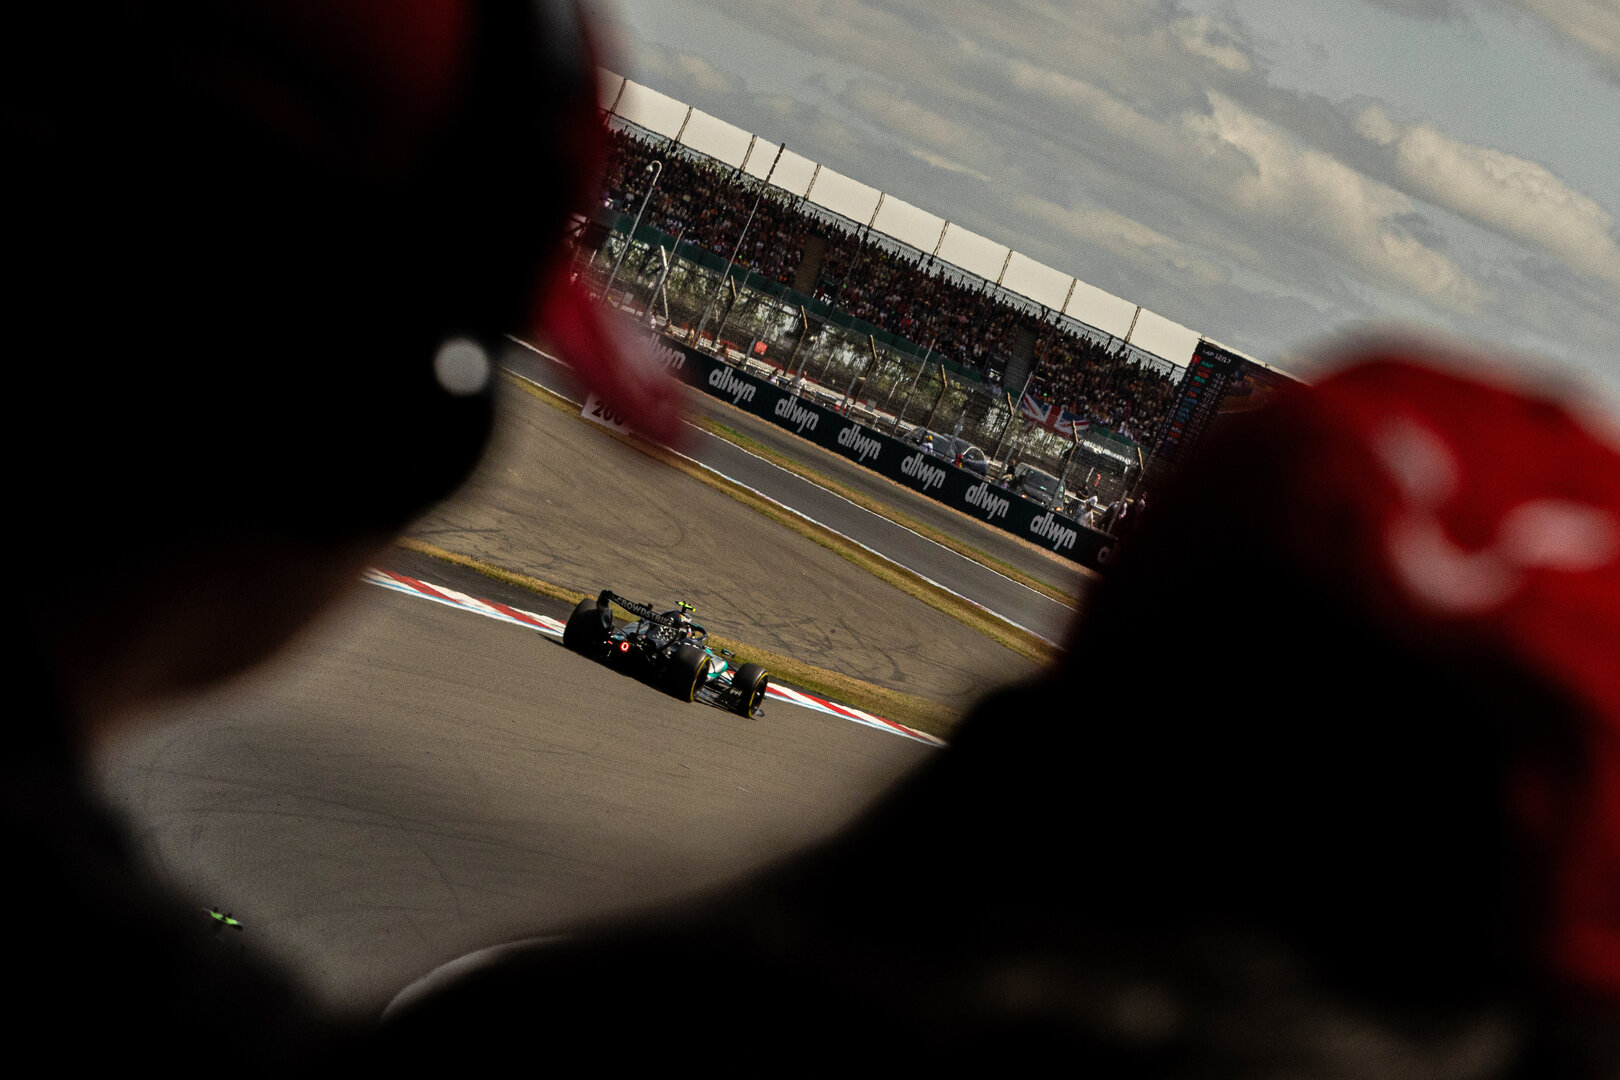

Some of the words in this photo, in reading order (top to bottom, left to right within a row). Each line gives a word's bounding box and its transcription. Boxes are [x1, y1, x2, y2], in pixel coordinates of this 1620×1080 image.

[640, 332, 686, 371] llwyn
[708, 366, 757, 404] allwyn
[774, 395, 820, 433] allwyn
[837, 423, 882, 462] allwyn
[900, 452, 946, 490] allwyn
[964, 481, 1010, 519] allwyn
[1029, 511, 1078, 550] allwyn
